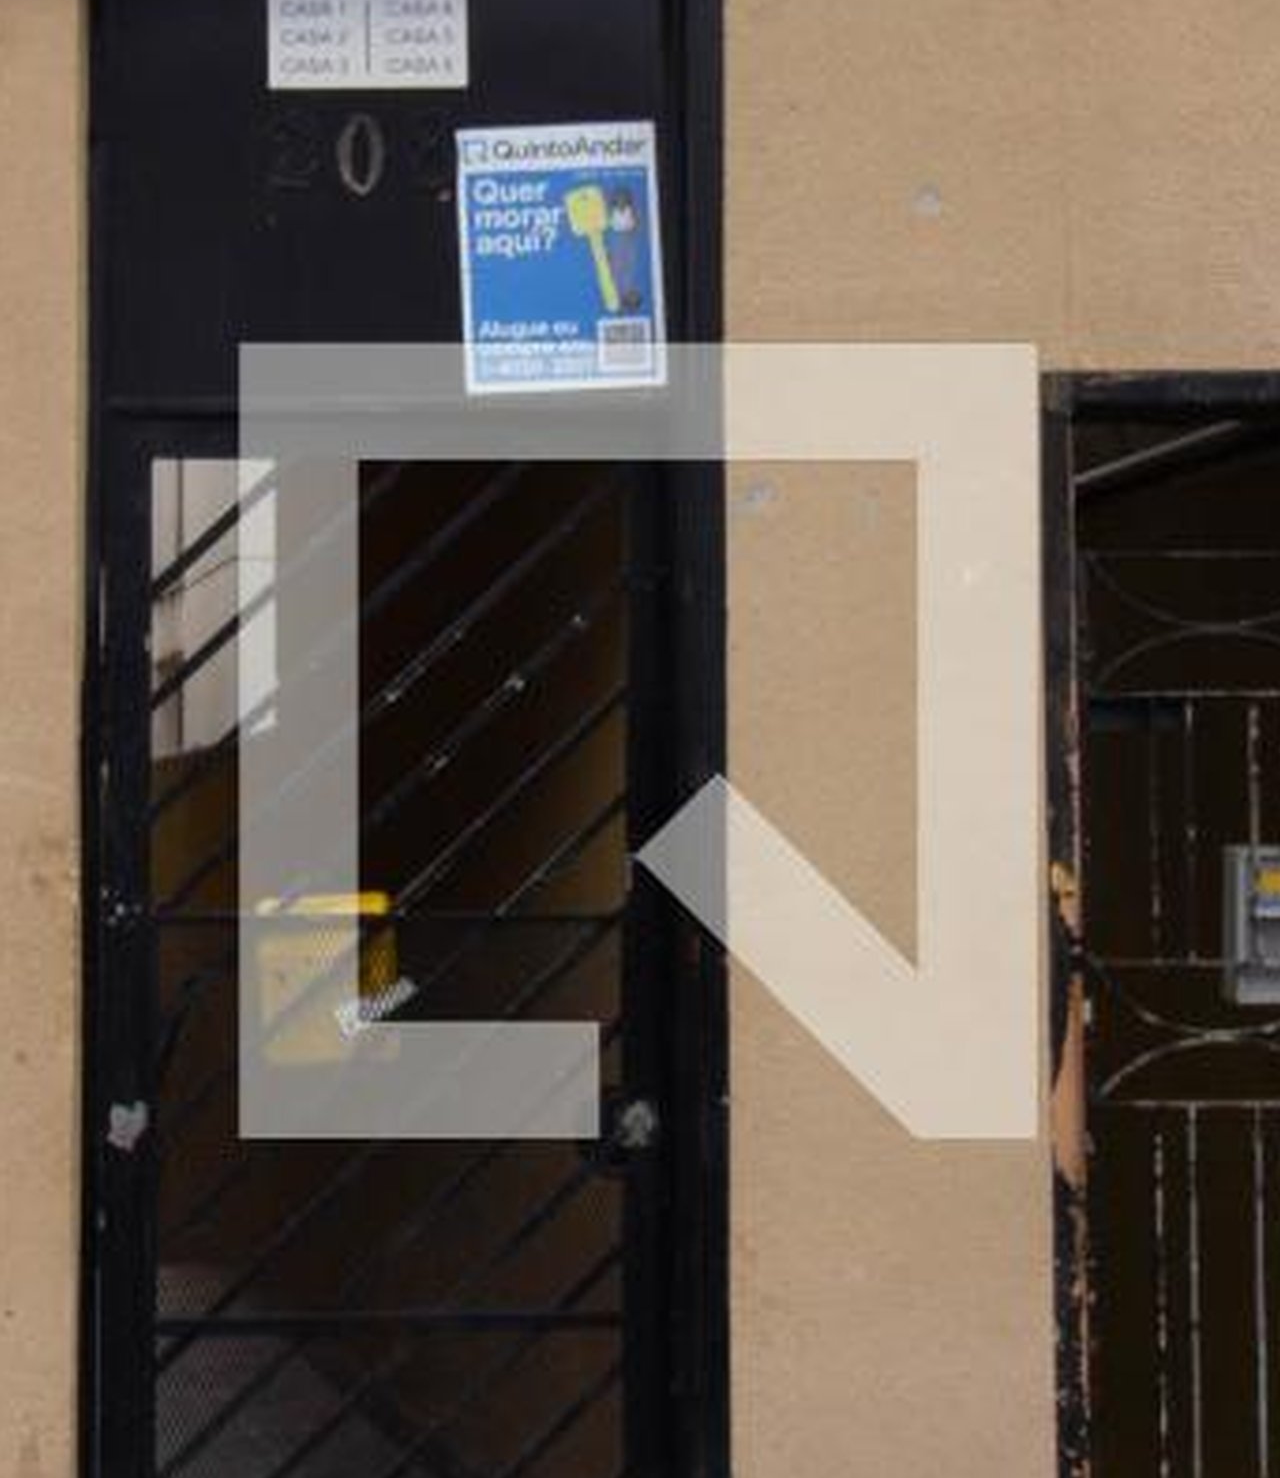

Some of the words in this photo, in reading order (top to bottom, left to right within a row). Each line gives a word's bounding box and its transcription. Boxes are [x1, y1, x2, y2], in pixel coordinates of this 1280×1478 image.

[492, 135, 647, 162] QuintoAndar
[472, 177, 549, 205] Quer
[473, 204, 563, 232] morar
[476, 225, 558, 259] aqui?
